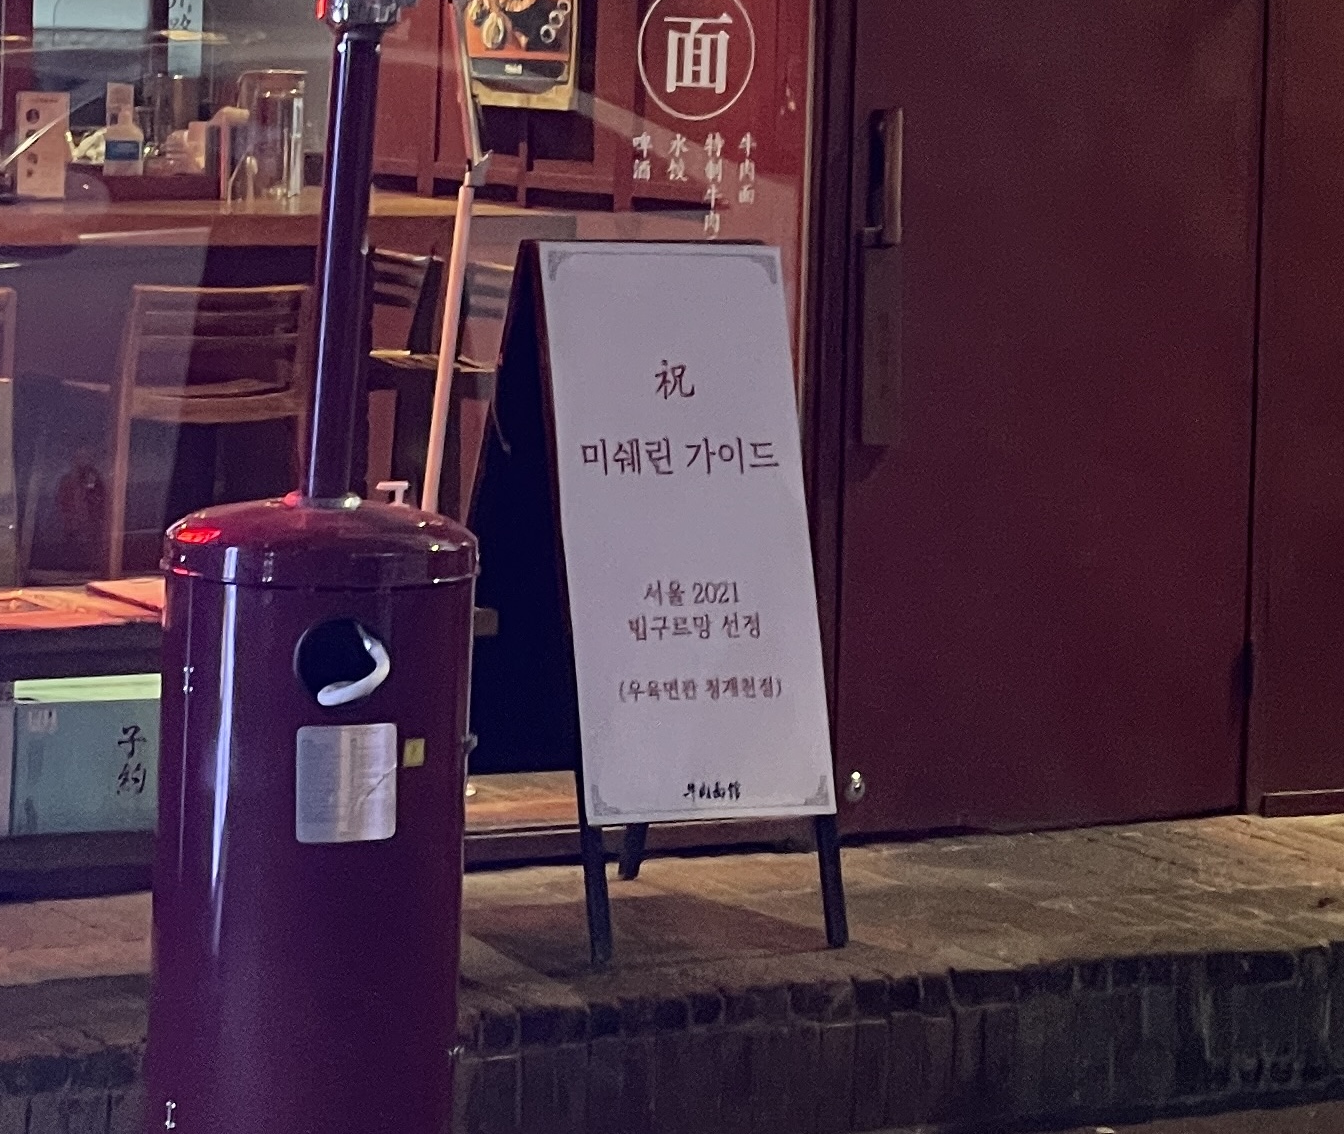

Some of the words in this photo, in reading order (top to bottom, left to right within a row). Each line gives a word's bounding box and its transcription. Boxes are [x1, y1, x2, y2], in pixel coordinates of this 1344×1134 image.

[664, 12, 733, 95] 面
[656, 359, 696, 401] 祝
[581, 437, 674, 476] 미쉐린
[686, 436, 780, 476] 가이드
[643, 580, 686, 607] 서울
[692, 581, 741, 606] 2021
[721, 613, 762, 640] 선정
